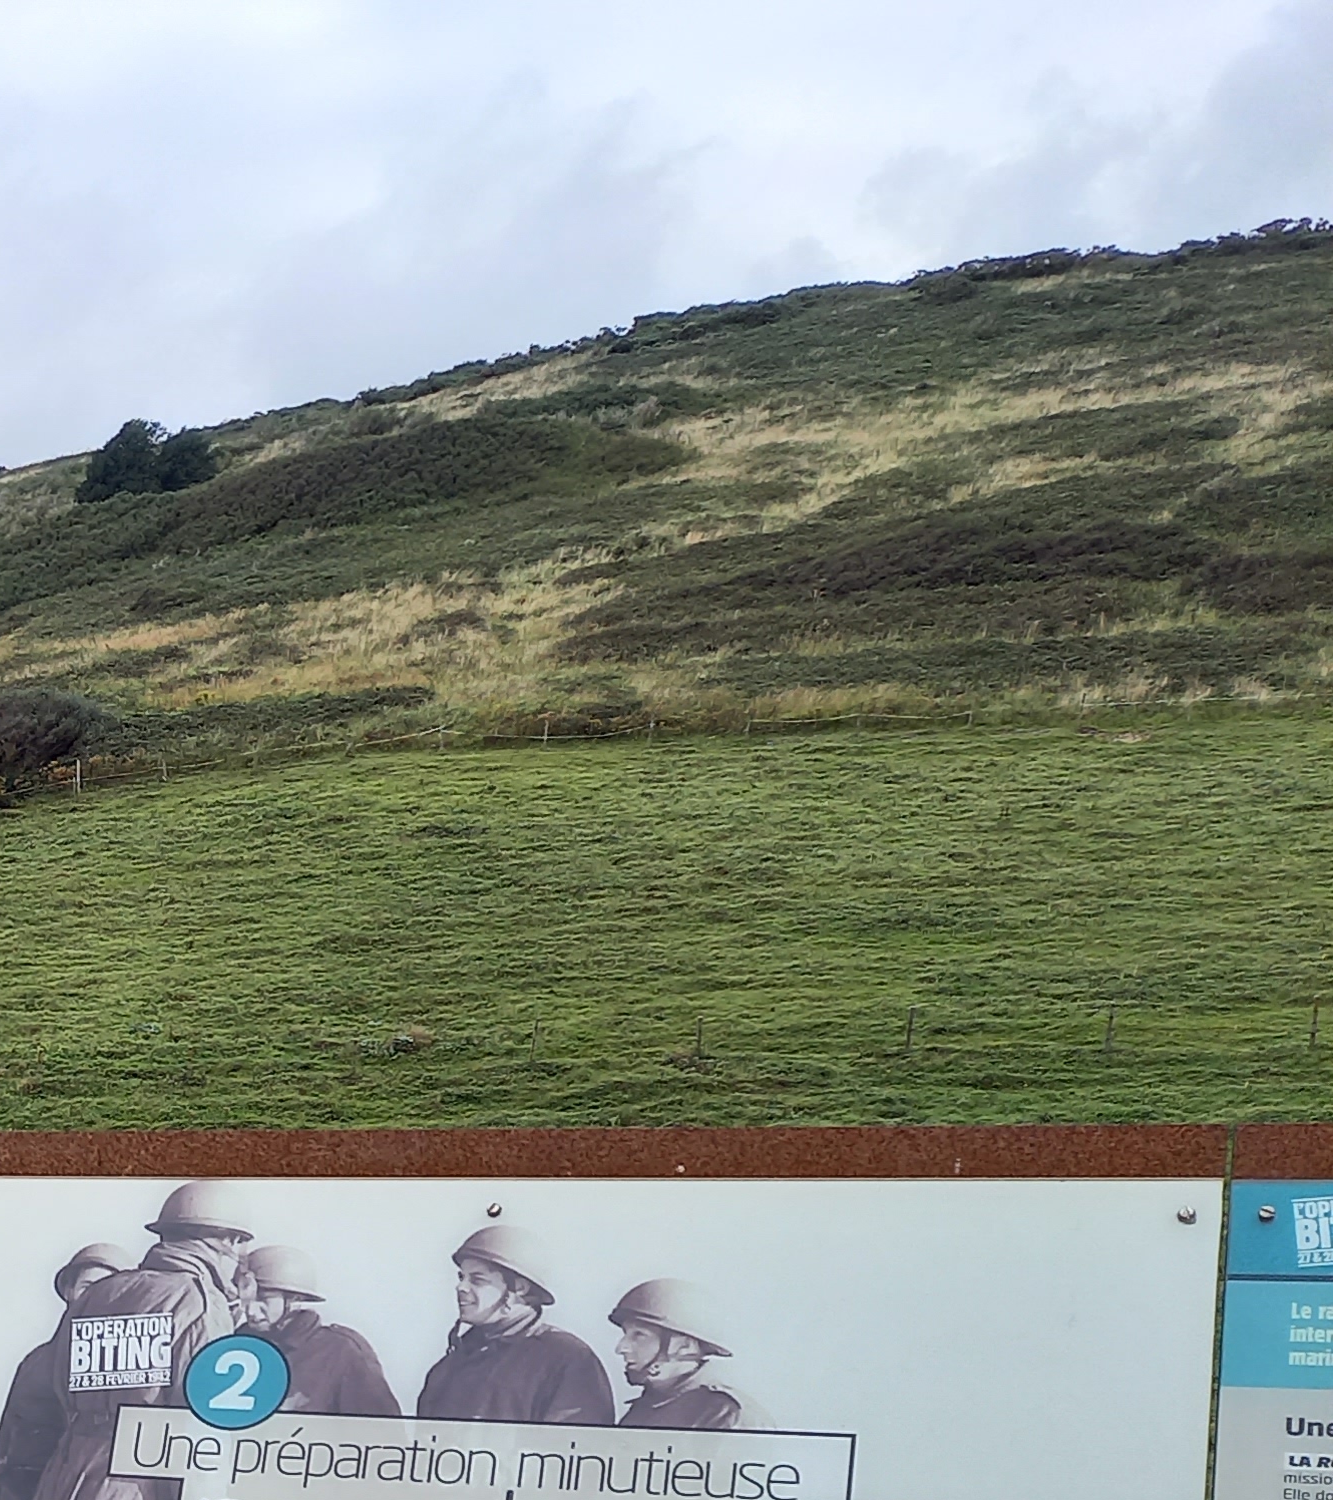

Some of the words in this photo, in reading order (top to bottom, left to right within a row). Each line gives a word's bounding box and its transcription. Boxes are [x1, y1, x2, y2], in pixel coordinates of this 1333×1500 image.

[1296, 1217, 1333, 1250] BI
[1297, 1252, 1311, 1264] 27
[1312, 1252, 1322, 1263] &
[1291, 1302, 1312, 1320] Le
[70, 1335, 172, 1373] BITING
[69, 1376, 82, 1388] 27
[82, 1375, 91, 1387] &
[91, 1374, 104, 1386] 28
[208, 1350, 261, 1411] 2
[133, 1421, 220, 1472] Une
[231, 1426, 497, 1487] préparation
[1288, 1455, 1311, 1467] LA
[1283, 1488, 1310, 1500] Elle
